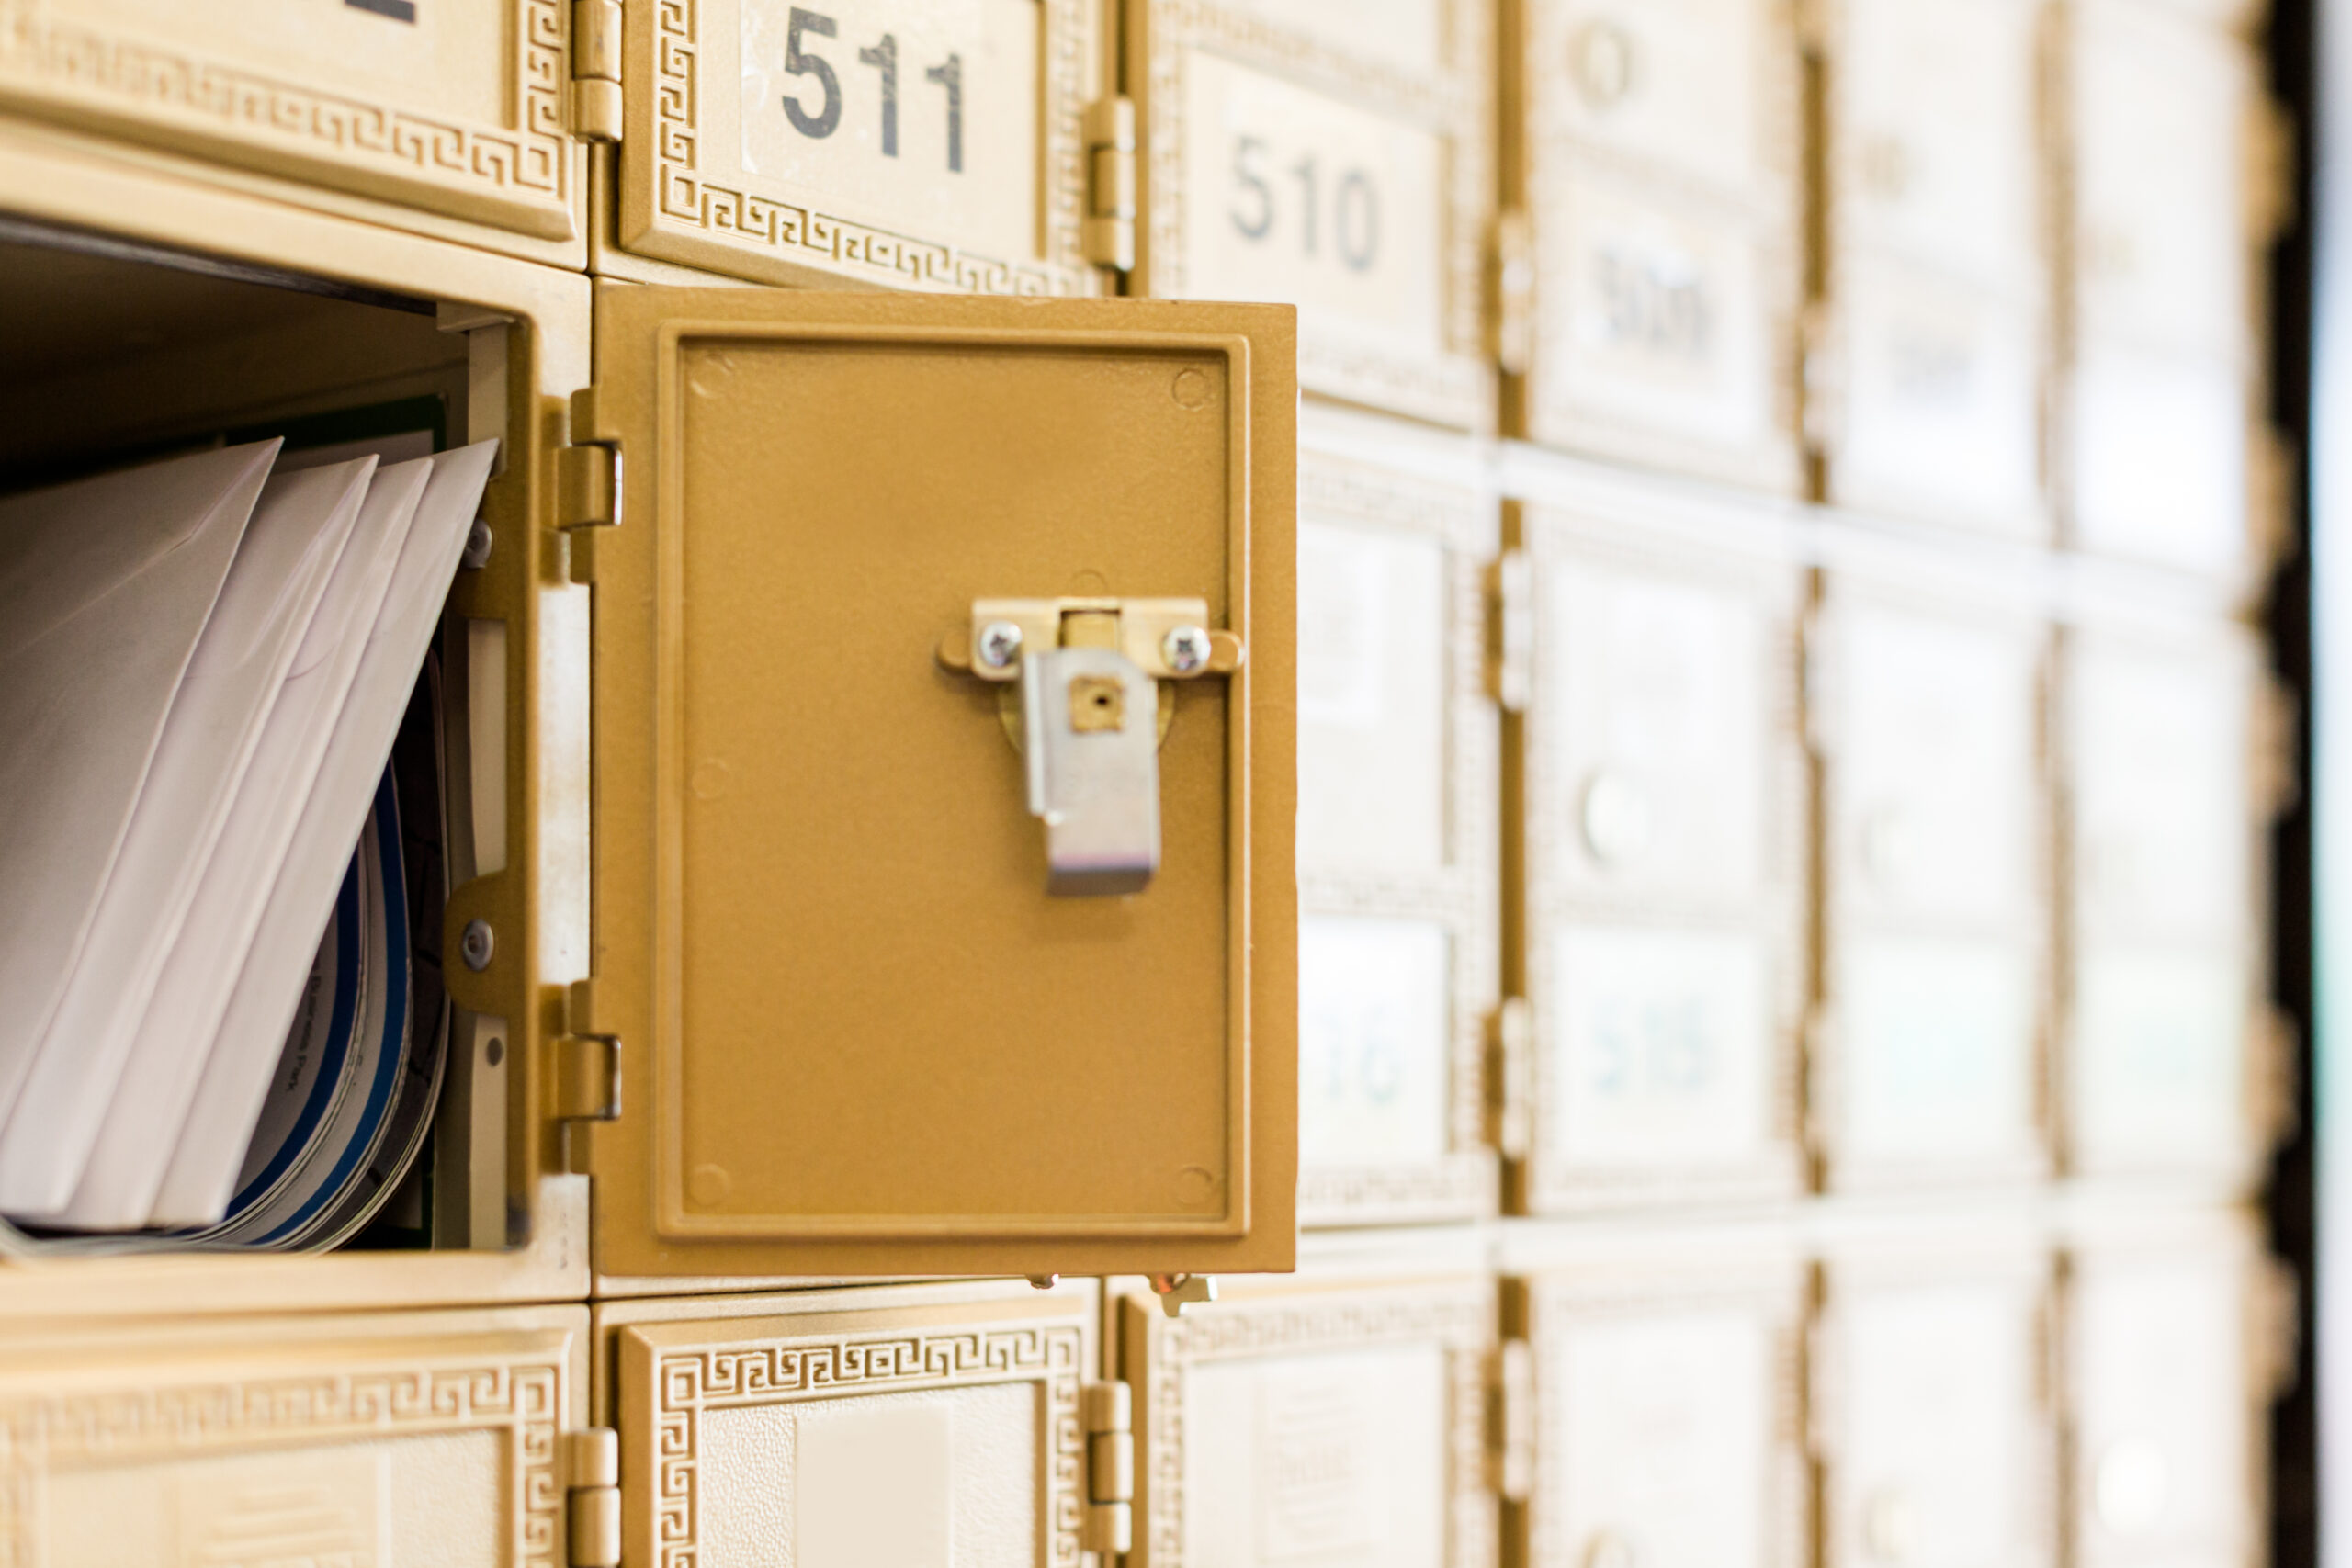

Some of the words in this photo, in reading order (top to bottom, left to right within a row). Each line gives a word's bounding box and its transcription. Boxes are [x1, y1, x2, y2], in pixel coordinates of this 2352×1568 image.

[781, 6, 962, 173] 511
[1228, 134, 1381, 275] 510
[286, 1055, 307, 1092] Park
